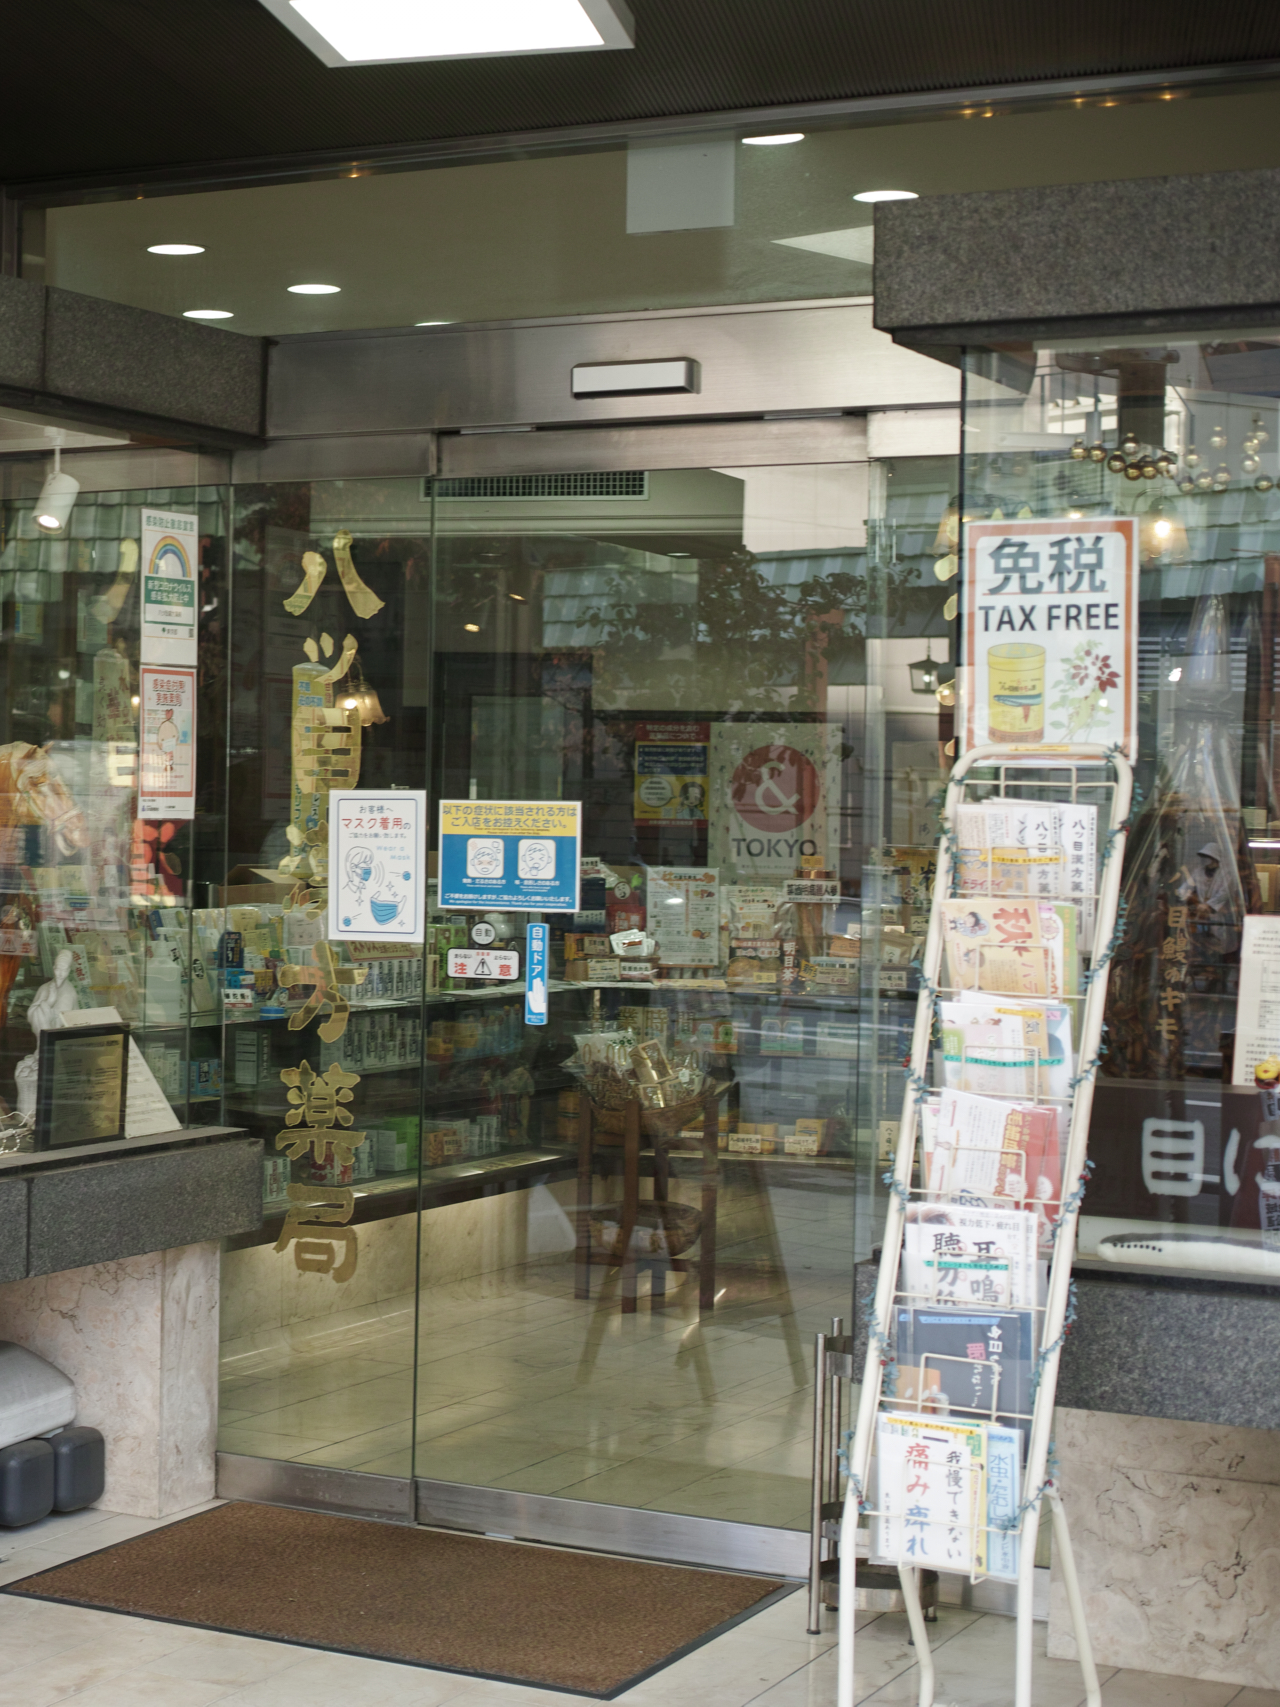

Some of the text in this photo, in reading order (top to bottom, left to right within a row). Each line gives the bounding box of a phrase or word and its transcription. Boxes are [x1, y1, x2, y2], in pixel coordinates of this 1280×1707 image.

[988, 536, 1107, 595] 免税
[978, 603, 1120, 631] TAX FREE
[755, 761, 801, 815] &
[359, 805, 394, 814] お客様へ
[443, 804, 577, 817] 以下の症状に該当される方は
[342, 816, 412, 830] マスク着用の
[451, 817, 568, 829] ご入店をお控えください。
[731, 838, 818, 858] TOKYO
[475, 928, 492, 938] 自動
[531, 926, 543, 976] 自動ドア
[454, 962, 512, 976] 注 意
[946, 1450, 963, 1559] 我慢できない
